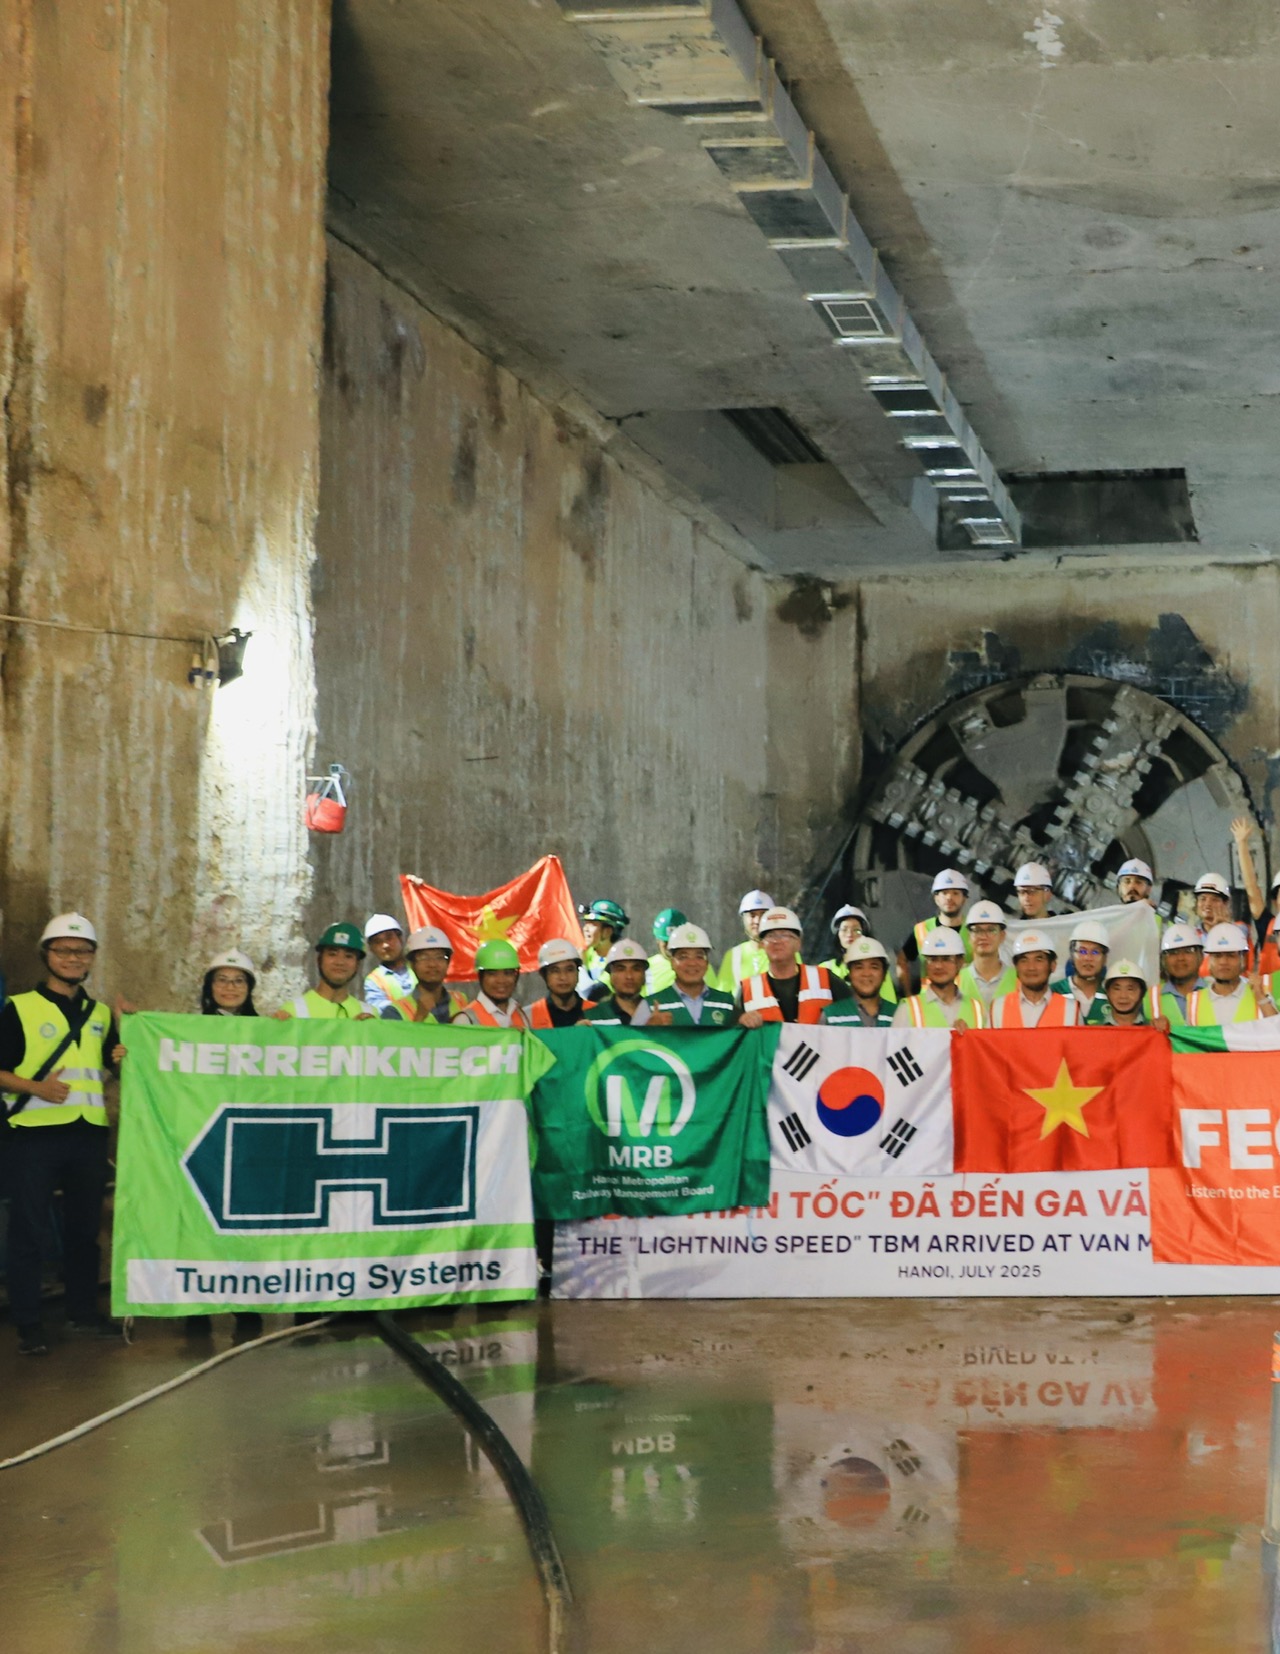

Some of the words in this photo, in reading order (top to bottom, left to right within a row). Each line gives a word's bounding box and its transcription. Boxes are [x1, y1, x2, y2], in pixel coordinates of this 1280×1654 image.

[158, 1038, 524, 1078] HERRENKNECH
[609, 1145, 673, 1168] MRB
[622, 1175, 689, 1187] Metropolitan
[681, 1184, 714, 1197] Board
[1186, 1183, 1227, 1199] Listen
[1228, 1185, 1244, 1199] to
[1246, 1183, 1271, 1199] the
[889, 1182, 941, 1218] ĐÃ
[950, 1177, 1024, 1218] ĐẾN
[1035, 1189, 1088, 1217] GA
[577, 1237, 622, 1255] THE
[629, 1236, 768, 1254] "LIGHTNING
[774, 1235, 861, 1253] SPEED"
[868, 1235, 920, 1253] TBM
[927, 1234, 1035, 1253] ARRIVED
[1042, 1234, 1072, 1252] AT
[1080, 1234, 1130, 1252] VAN
[176, 1266, 356, 1297] Tunnelling
[368, 1260, 502, 1294] Systems
[898, 1266, 954, 1279] HANOI,
[959, 1266, 996, 1279] JULY
[1000, 1265, 1042, 1279] 2025
